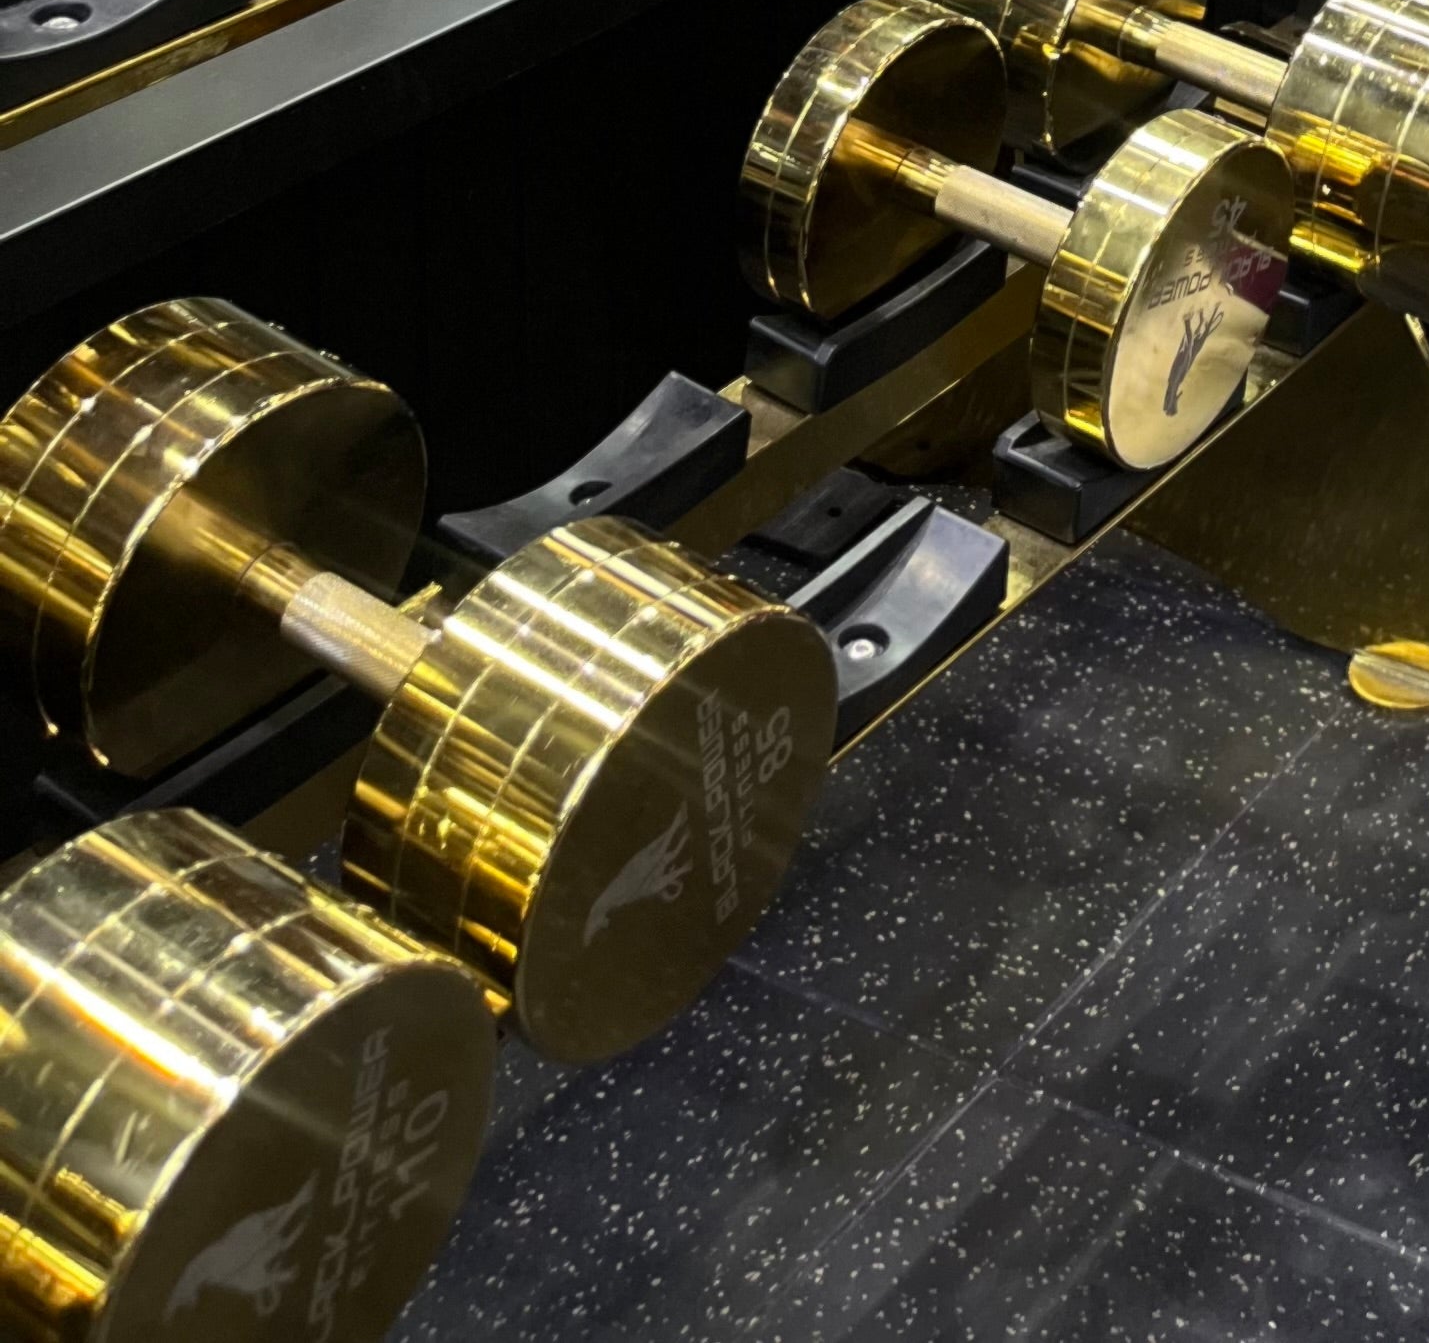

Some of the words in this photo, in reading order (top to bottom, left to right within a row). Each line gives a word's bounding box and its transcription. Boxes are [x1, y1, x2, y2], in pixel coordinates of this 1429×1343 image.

[1208, 195, 1247, 239] 45
[756, 706, 792, 784] 85
[389, 1090, 448, 1219] 110
